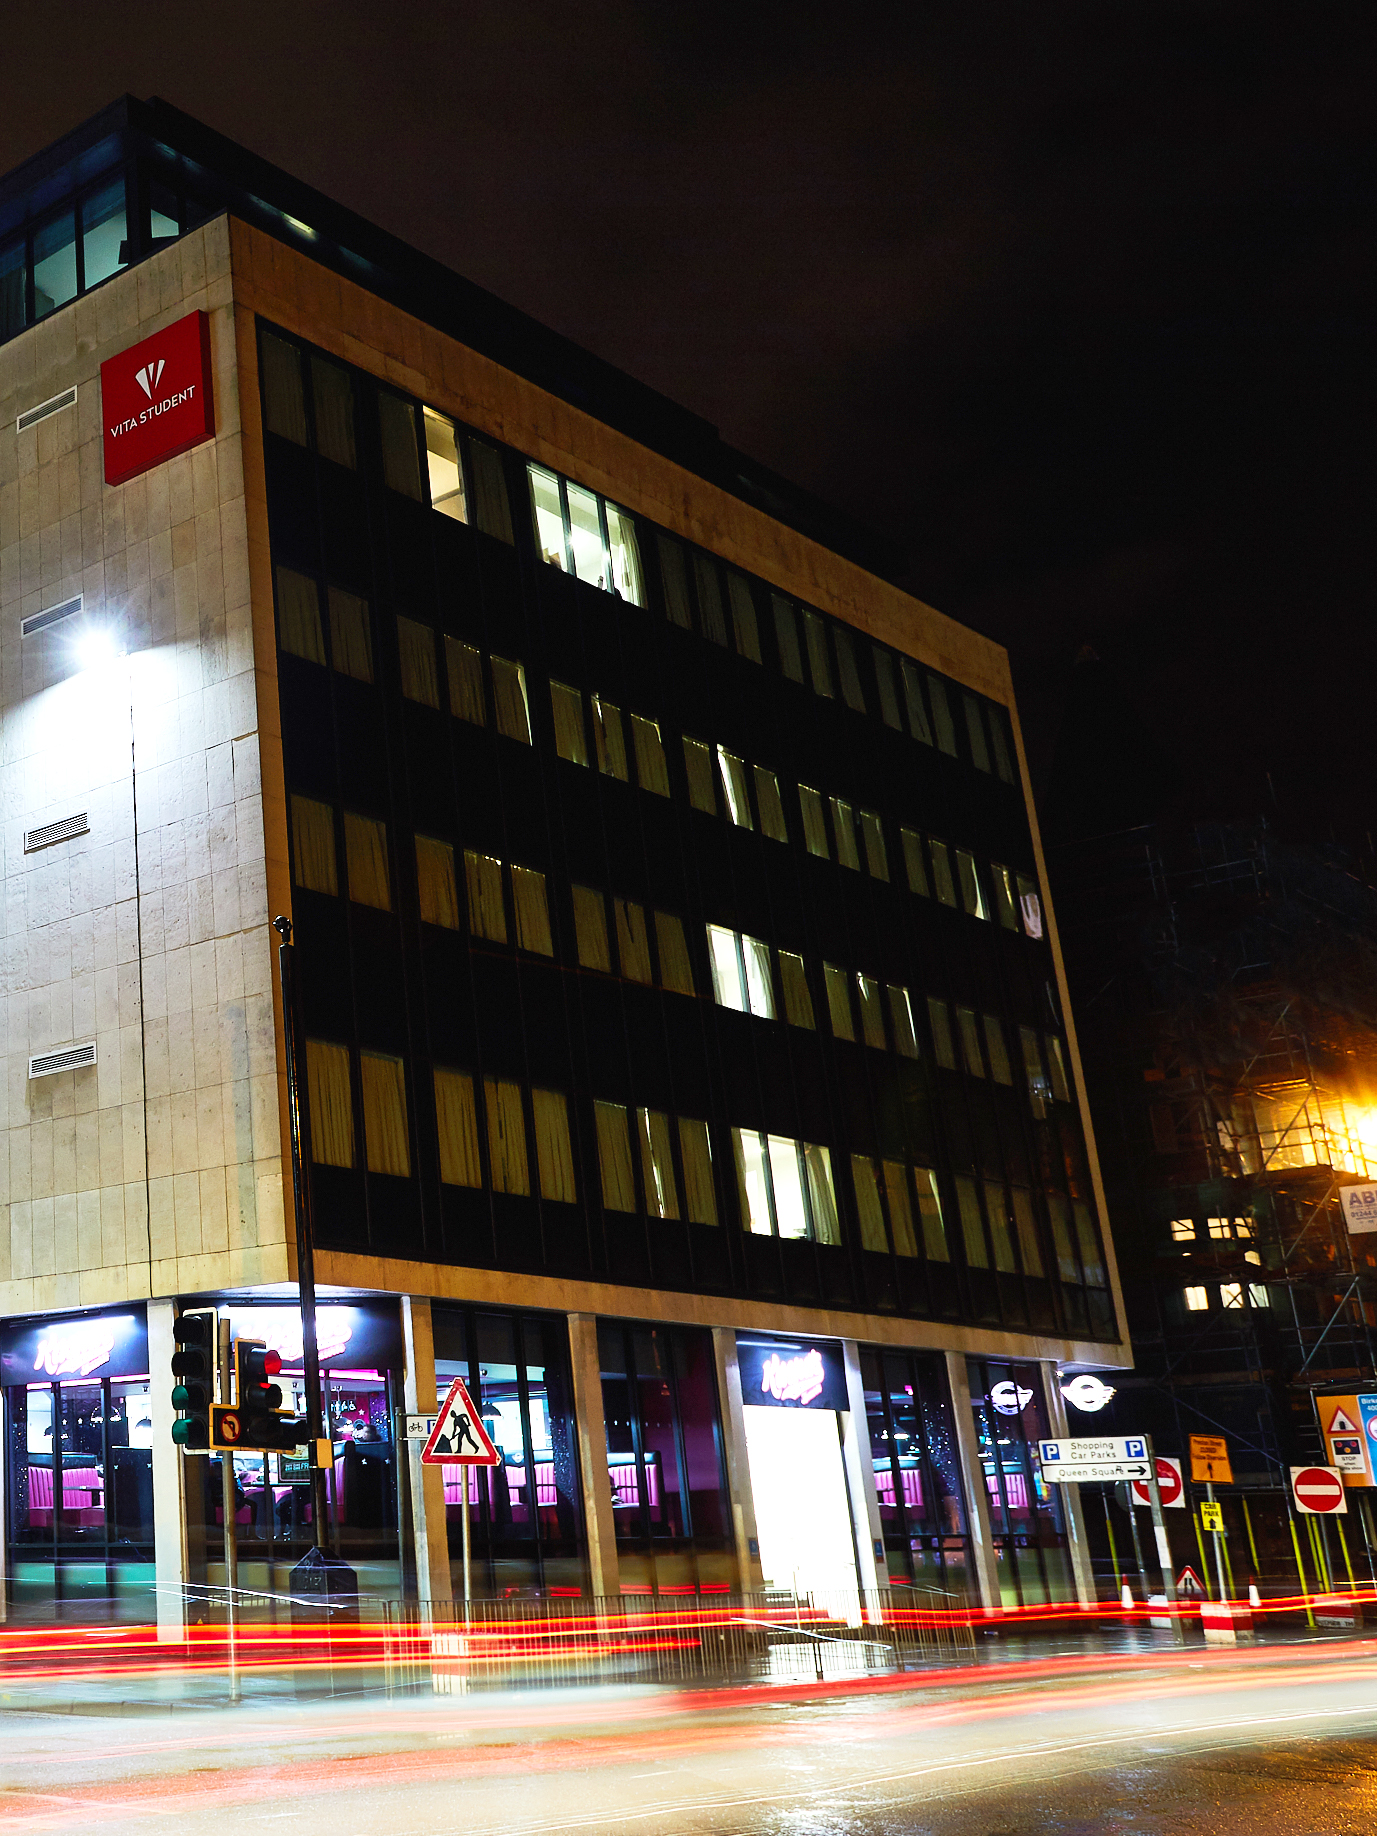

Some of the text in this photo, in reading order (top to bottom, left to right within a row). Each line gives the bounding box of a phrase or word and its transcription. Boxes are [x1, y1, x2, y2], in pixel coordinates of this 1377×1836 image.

[110, 385, 196, 438] VITA STUDENT
[1349, 1190, 1377, 1206] AB
[1070, 1441, 1114, 1450] Shopping
[1090, 1451, 1117, 1459] Parks
[1058, 1467, 1124, 1477] Queen Square
